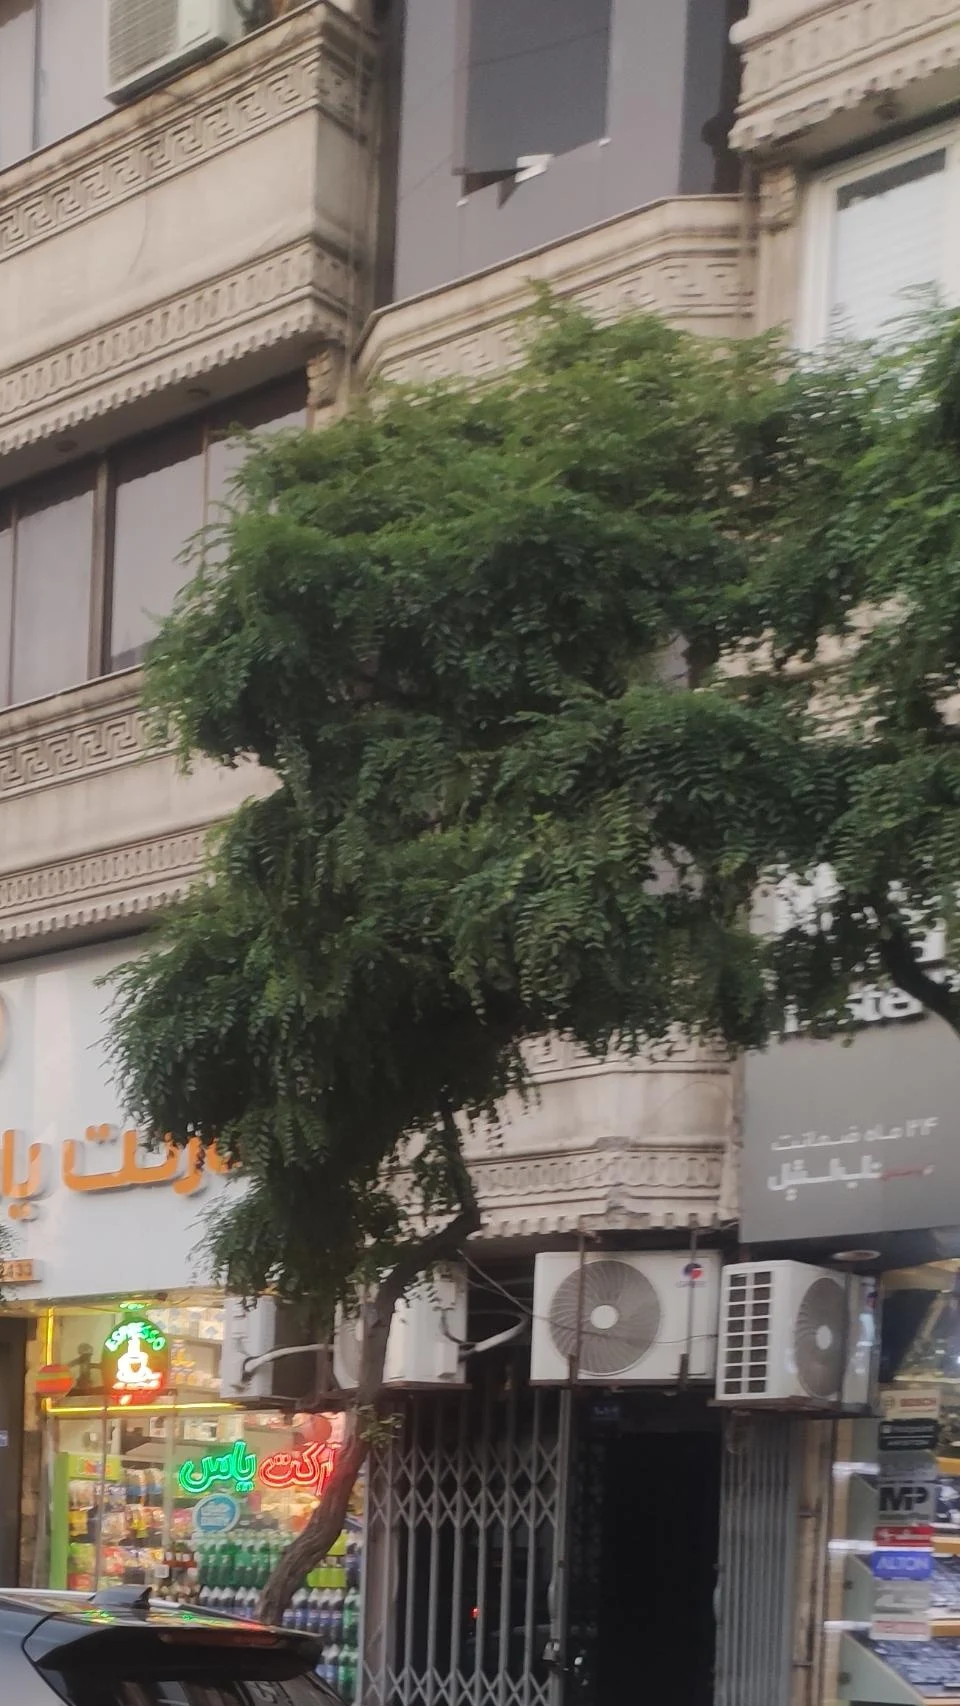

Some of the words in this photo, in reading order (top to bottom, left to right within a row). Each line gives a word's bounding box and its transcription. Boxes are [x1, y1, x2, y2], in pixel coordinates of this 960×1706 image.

[178, 1439, 257, 1493] یاس
[259, 1442, 336, 1497] ارکت
[876, 1556, 930, 1571] ALTON
